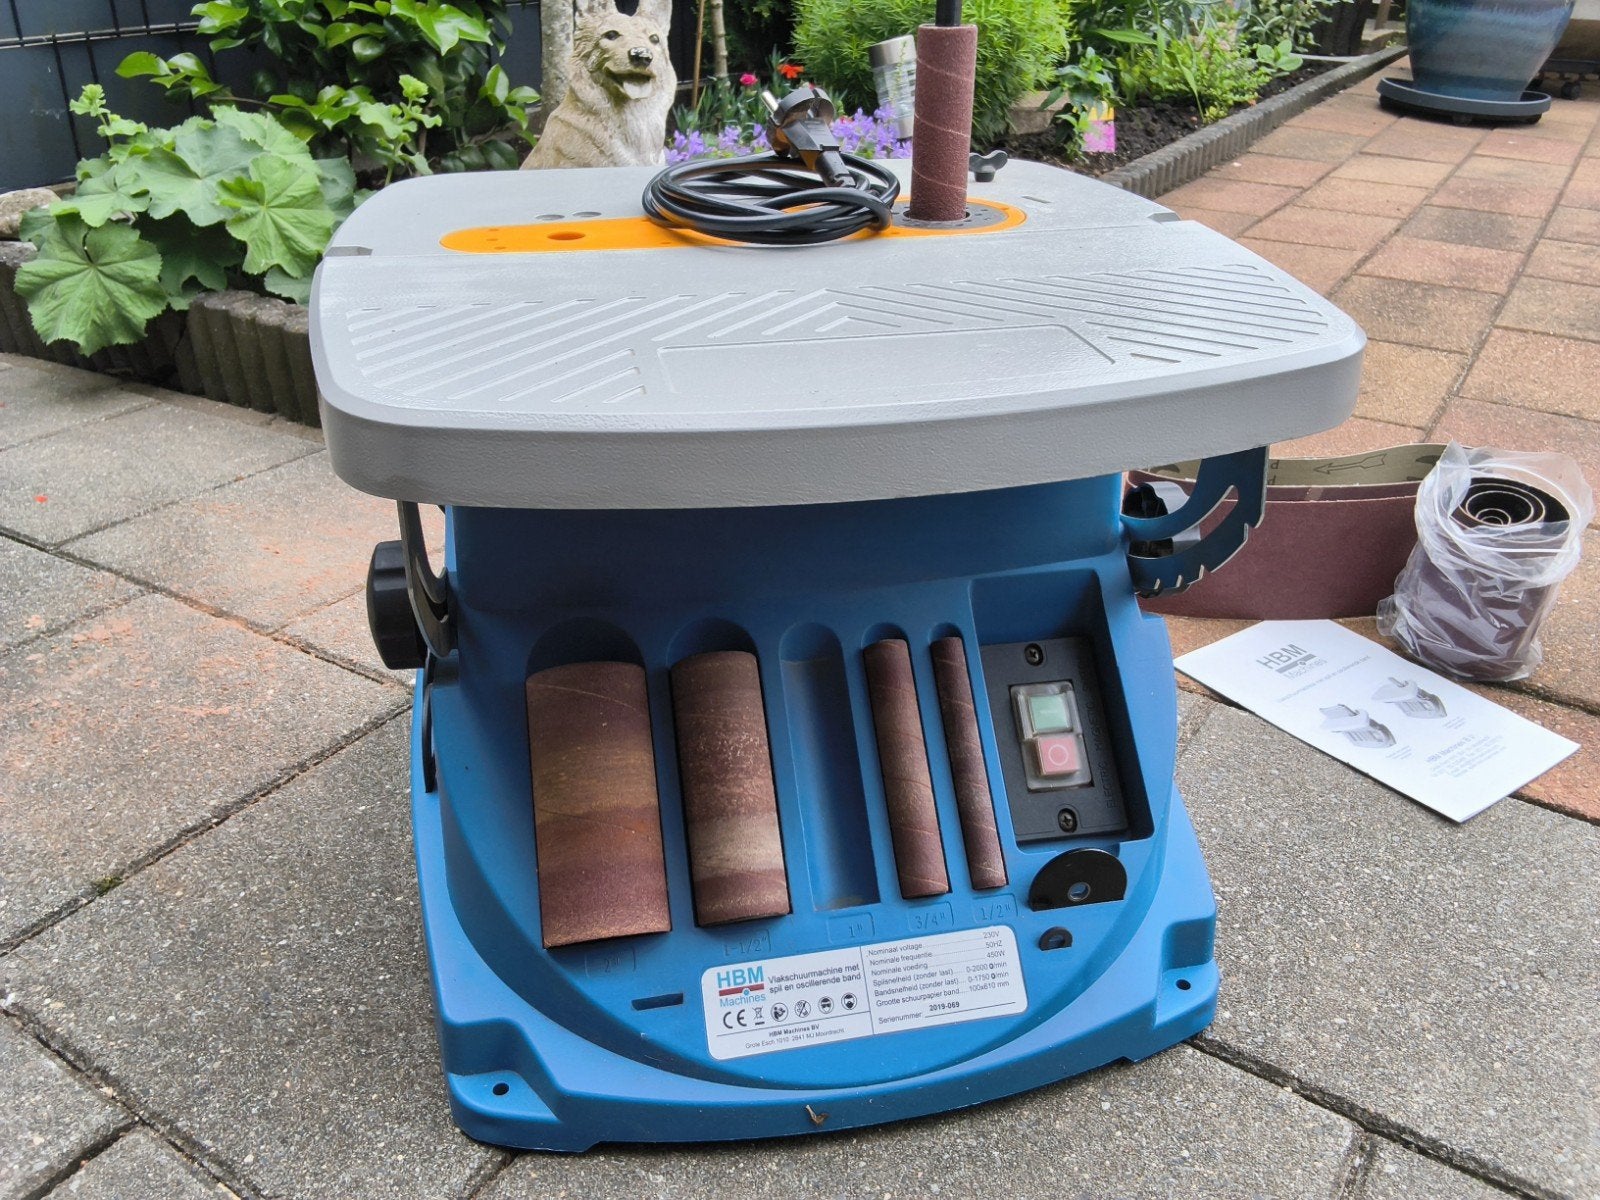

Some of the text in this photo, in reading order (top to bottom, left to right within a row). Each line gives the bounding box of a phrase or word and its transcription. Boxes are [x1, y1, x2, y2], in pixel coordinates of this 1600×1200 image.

[1256, 644, 1307, 669] HBM
[915, 913, 946, 930] 3/4"
[869, 931, 1000, 956] Nominaal voltage 230V
[870, 940, 1002, 966] Nominale frequentie 50HZ
[768, 963, 860, 984] Vlakschuurmachine met
[872, 950, 1005, 976] Nominale voeding 450W
[914, 971, 937, 982] (zonder
[939, 968, 954, 977] last)
[966, 963, 988, 973] 0-2000
[718, 966, 764, 988] HBM
[769, 972, 862, 994] spil en oscillerende band
[874, 984, 918, 997] Bandsnelheid
[920, 980, 943, 990] (zonder
[944, 977, 959, 986] last)
[968, 973, 990, 983] 0-1750
[720, 993, 766, 1008] Machines
[876, 997, 900, 1007] Grootte
[902, 991, 942, 1003] schuurpapier
[943, 988, 960, 997] band
[929, 1001, 960, 1012] 2019-069
[784, 1026, 810, 1035] Machines
